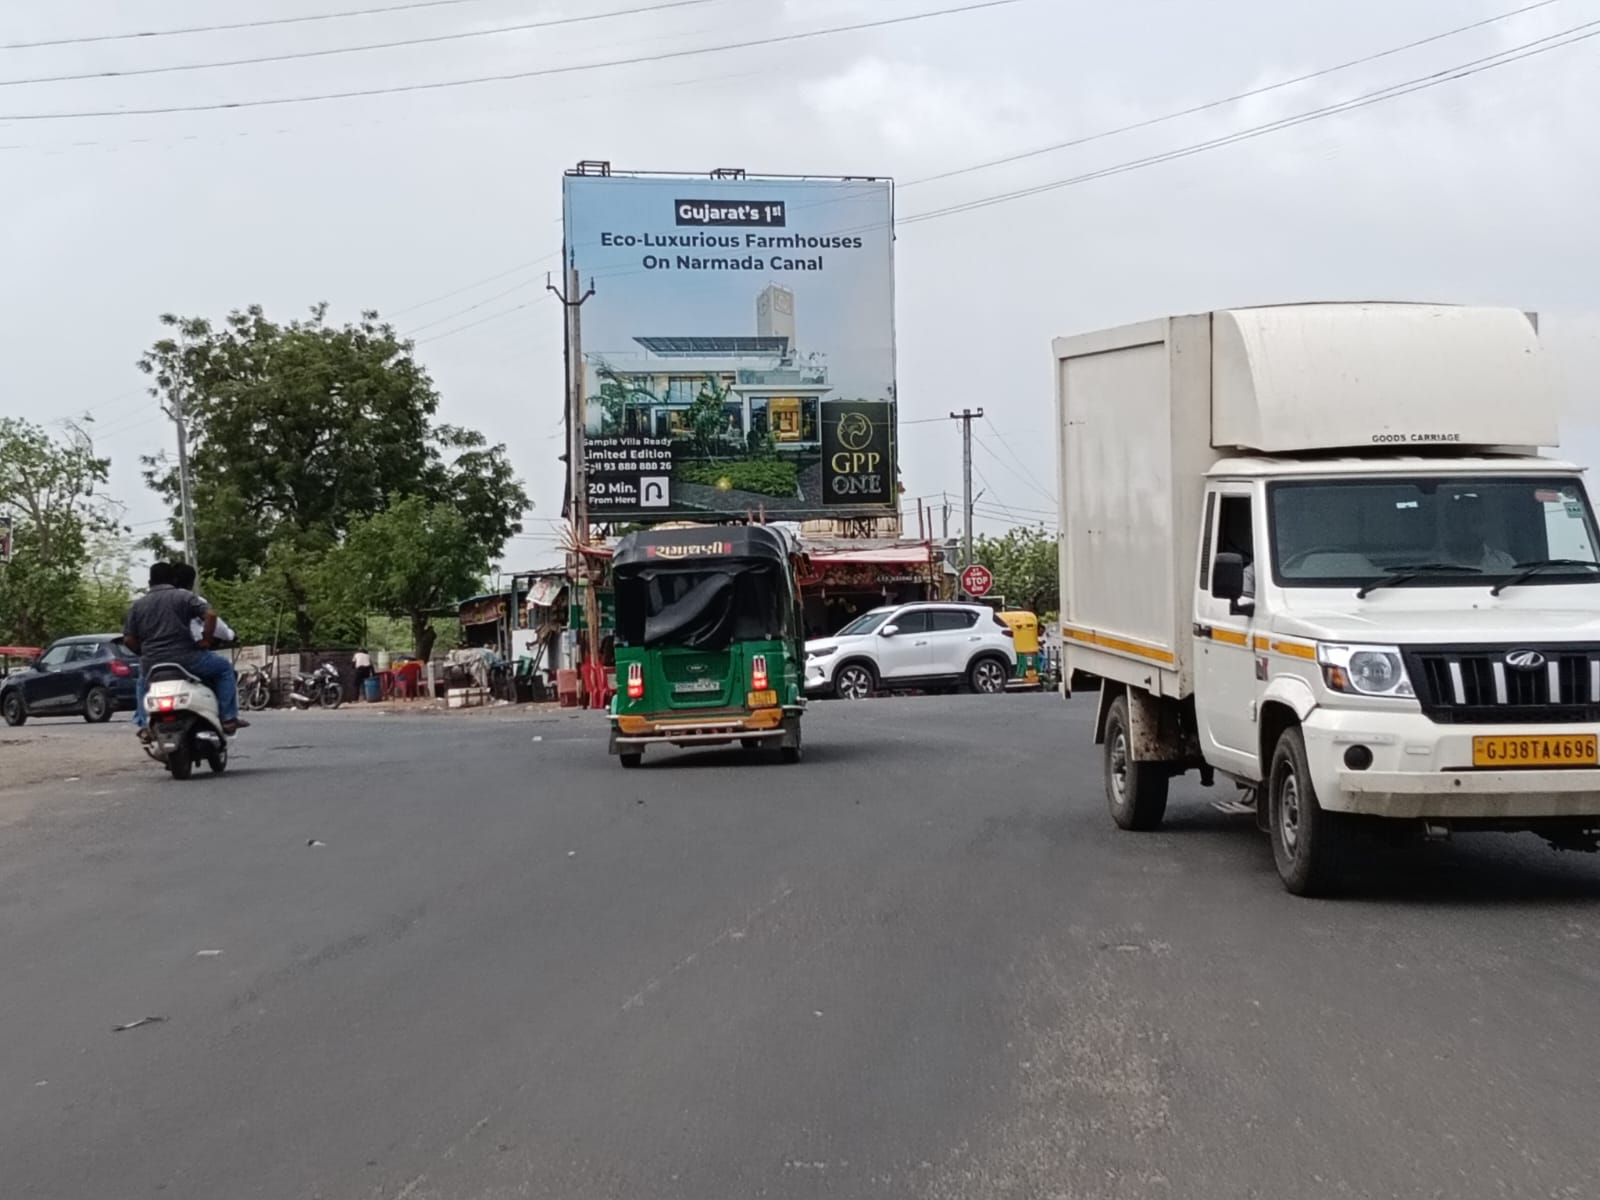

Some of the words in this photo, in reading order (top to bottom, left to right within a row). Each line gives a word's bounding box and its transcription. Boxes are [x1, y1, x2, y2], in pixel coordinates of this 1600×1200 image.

[679, 203, 760, 223] Gujarat's
[764, 205, 782, 223] 1st
[601, 231, 740, 248] Eco-Luxurious
[745, 233, 863, 249] Farmhouses
[642, 255, 670, 270] On
[676, 255, 764, 271] Narmada
[769, 255, 824, 271] Canal
[620, 438, 641, 446] Villa
[643, 437, 672, 447] Ready
[1371, 434, 1407, 443] GOODS
[1410, 433, 1461, 442] CARRIAGE
[583, 449, 627, 460] Limited
[630, 449, 672, 459] Edition
[603, 462, 616, 471] 93
[618, 462, 637, 471] 888
[659, 461, 672, 470] 26
[831, 452, 881, 474] GPP
[588, 483, 606, 495] 20
[608, 481, 638, 494] Min.
[832, 475, 882, 495] ONE
[588, 497, 613, 505] From
[614, 496, 637, 504] Here
[965, 576, 989, 586] STOP
[1486, 740, 1594, 760] GJ38TA4696
